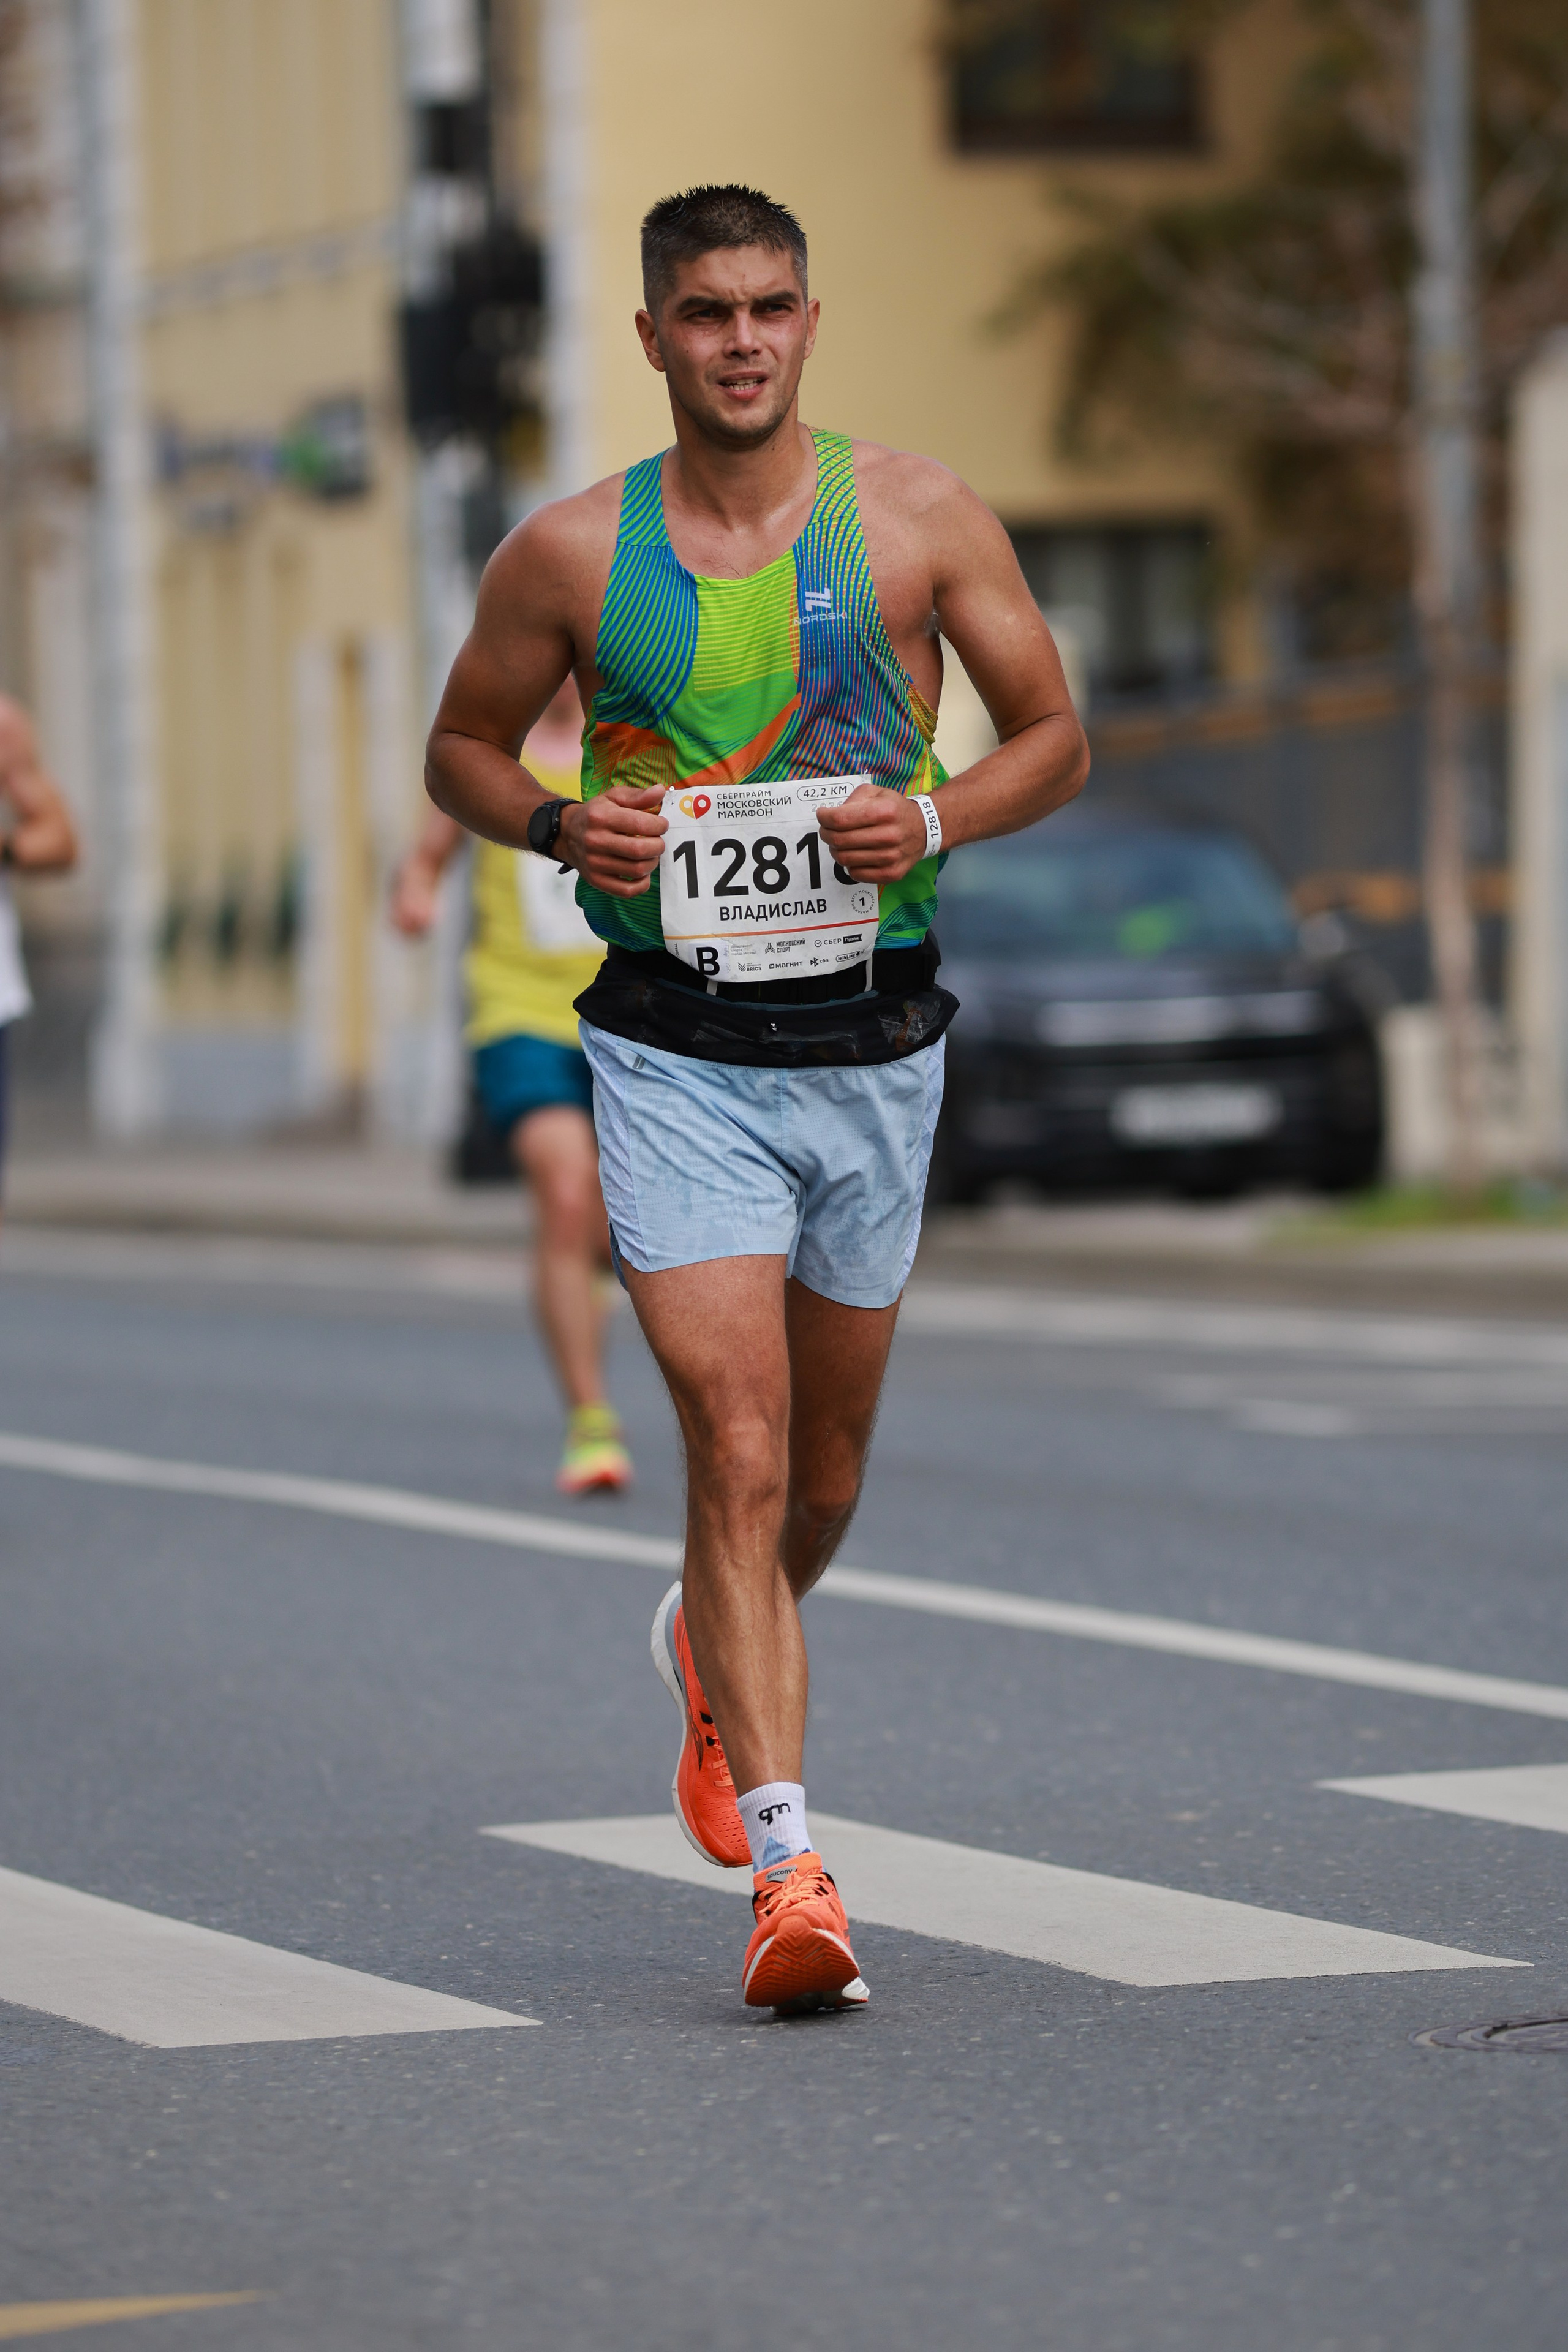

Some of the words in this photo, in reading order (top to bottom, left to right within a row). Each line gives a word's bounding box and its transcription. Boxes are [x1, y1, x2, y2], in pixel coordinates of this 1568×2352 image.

[793, 611, 848, 625] NORDSKI
[717, 790, 771, 800] СБЕРПРАЙМ
[803, 788, 826, 797] 42,2
[717, 795, 791, 809] МОСКОВСКИЙ
[718, 808, 772, 818] МАРАФОН
[922, 801, 939, 839] 12818
[859, 897, 865, 907] 1
[720, 898, 827, 922] ВЛАДИСЛАВ
[776, 938, 806, 947] МОСКОВСКИЙ
[838, 952, 856, 961] WINLINE
